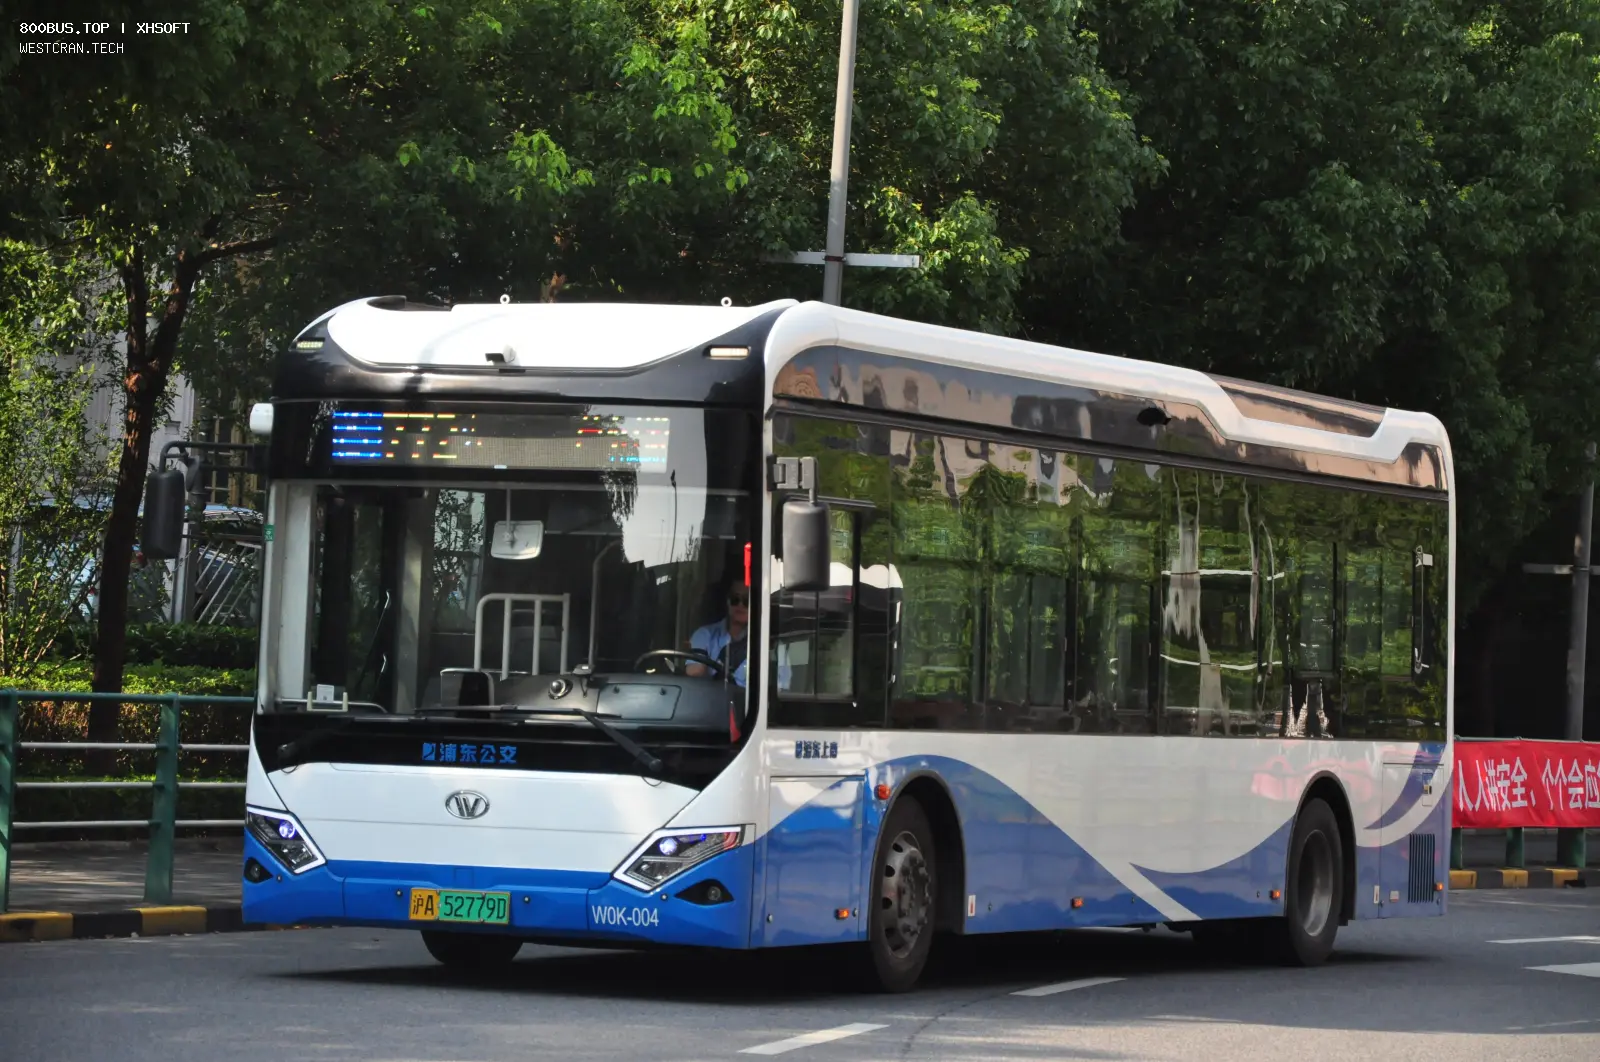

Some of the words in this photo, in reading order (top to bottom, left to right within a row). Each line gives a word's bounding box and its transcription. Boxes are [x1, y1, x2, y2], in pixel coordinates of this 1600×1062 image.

[439, 743, 517, 764] 浦东公交
[1458, 756, 1600, 813] 人人讲安全、个个会应
